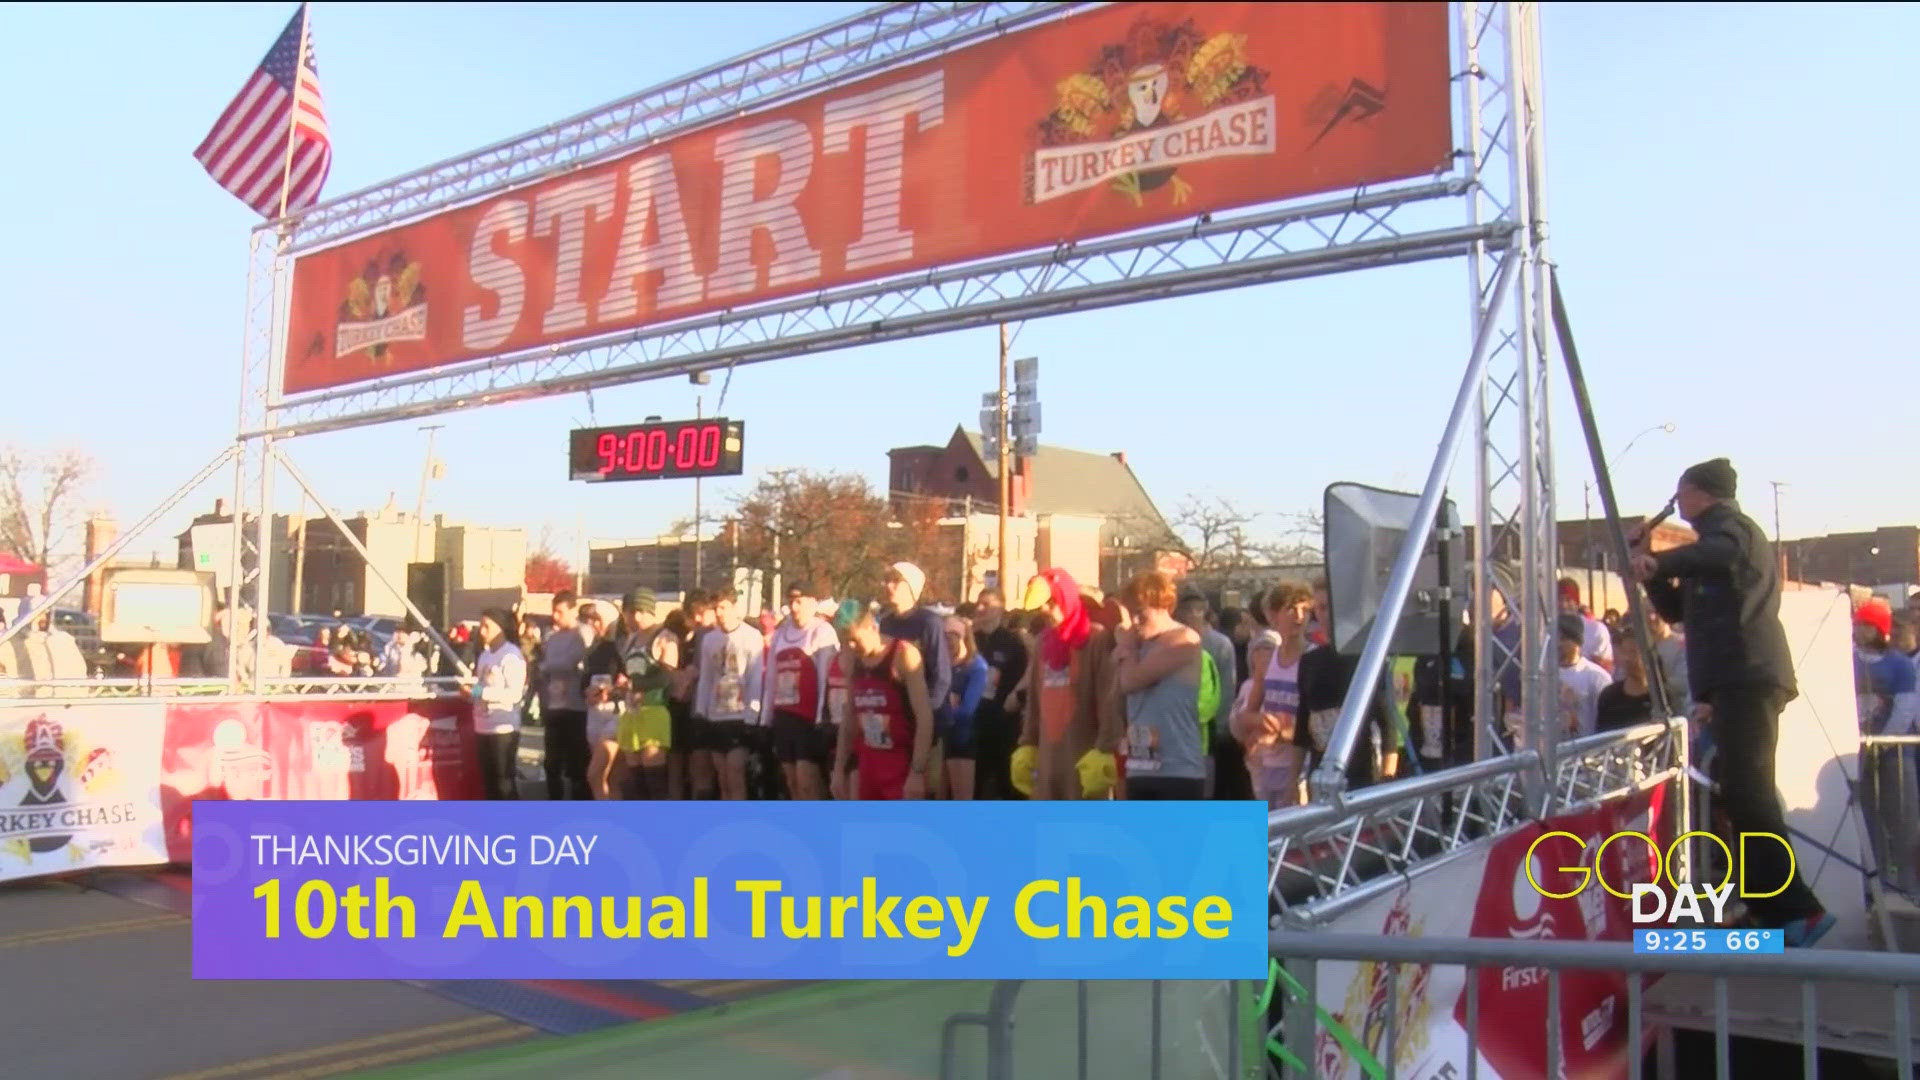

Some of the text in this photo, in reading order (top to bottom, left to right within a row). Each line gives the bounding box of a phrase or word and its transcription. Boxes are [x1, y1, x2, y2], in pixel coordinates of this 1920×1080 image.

[1041, 137, 1156, 193] TURKEY
[1162, 107, 1269, 160] CHASE
[462, 69, 944, 350] START
[60, 803, 137, 827] CHASE
